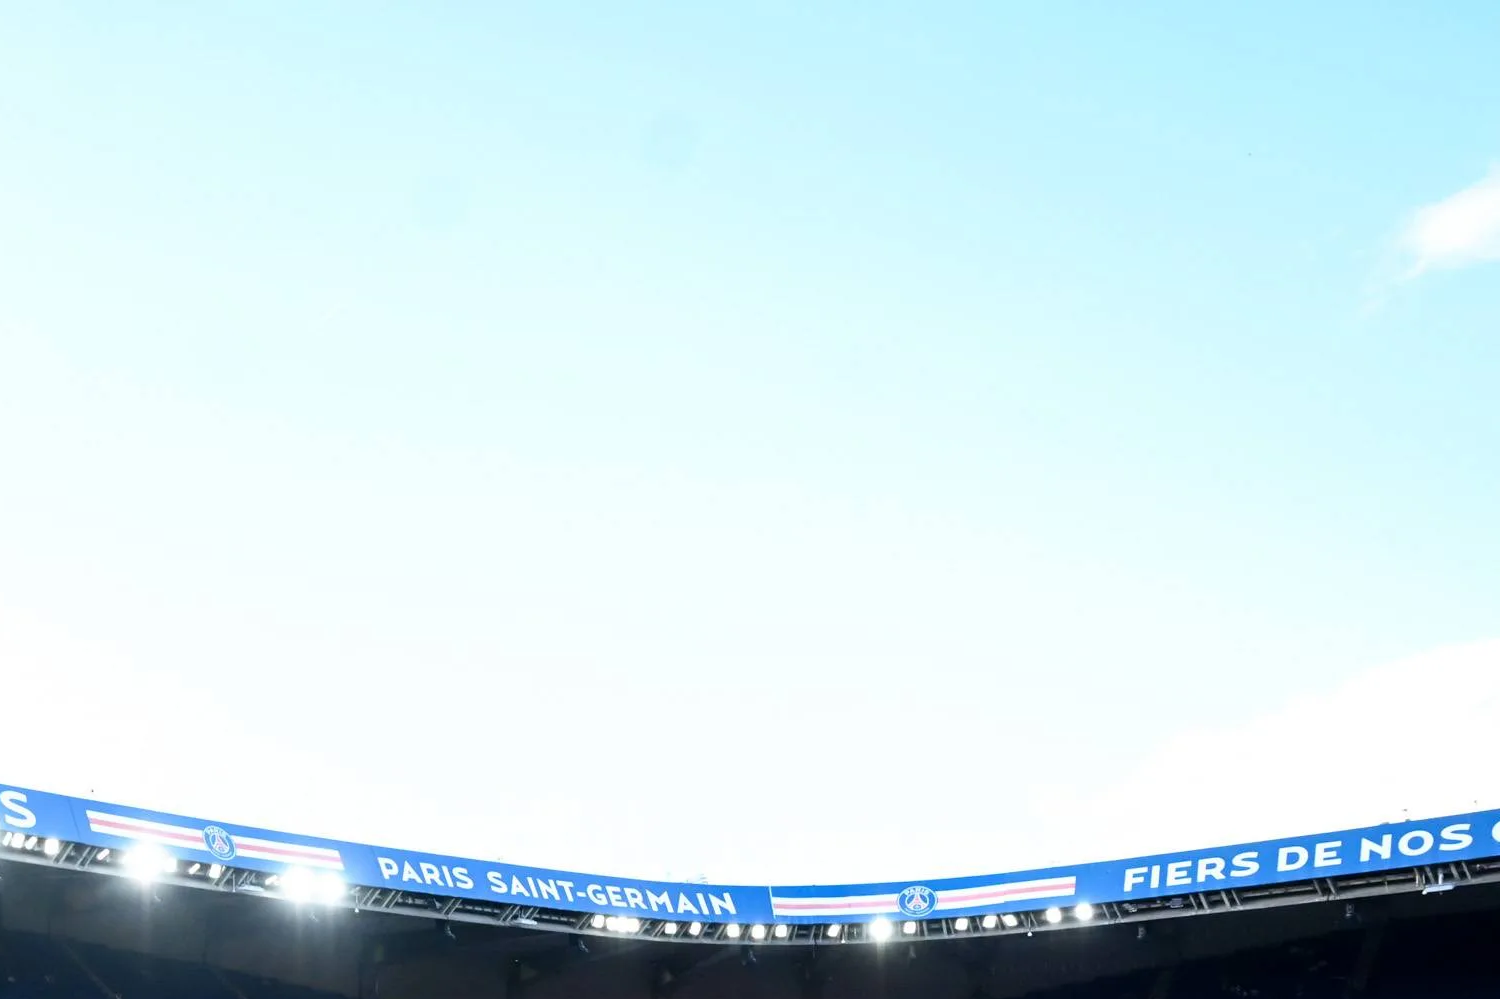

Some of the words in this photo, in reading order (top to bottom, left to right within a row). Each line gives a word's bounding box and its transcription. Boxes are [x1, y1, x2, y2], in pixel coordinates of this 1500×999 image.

[380, 857, 474, 890] PARIS
[489, 870, 737, 916] SAINT-GERMAIN
[1124, 851, 1260, 893] FIERS
[1276, 841, 1343, 873] DE
[1359, 823, 1474, 861] NOS
